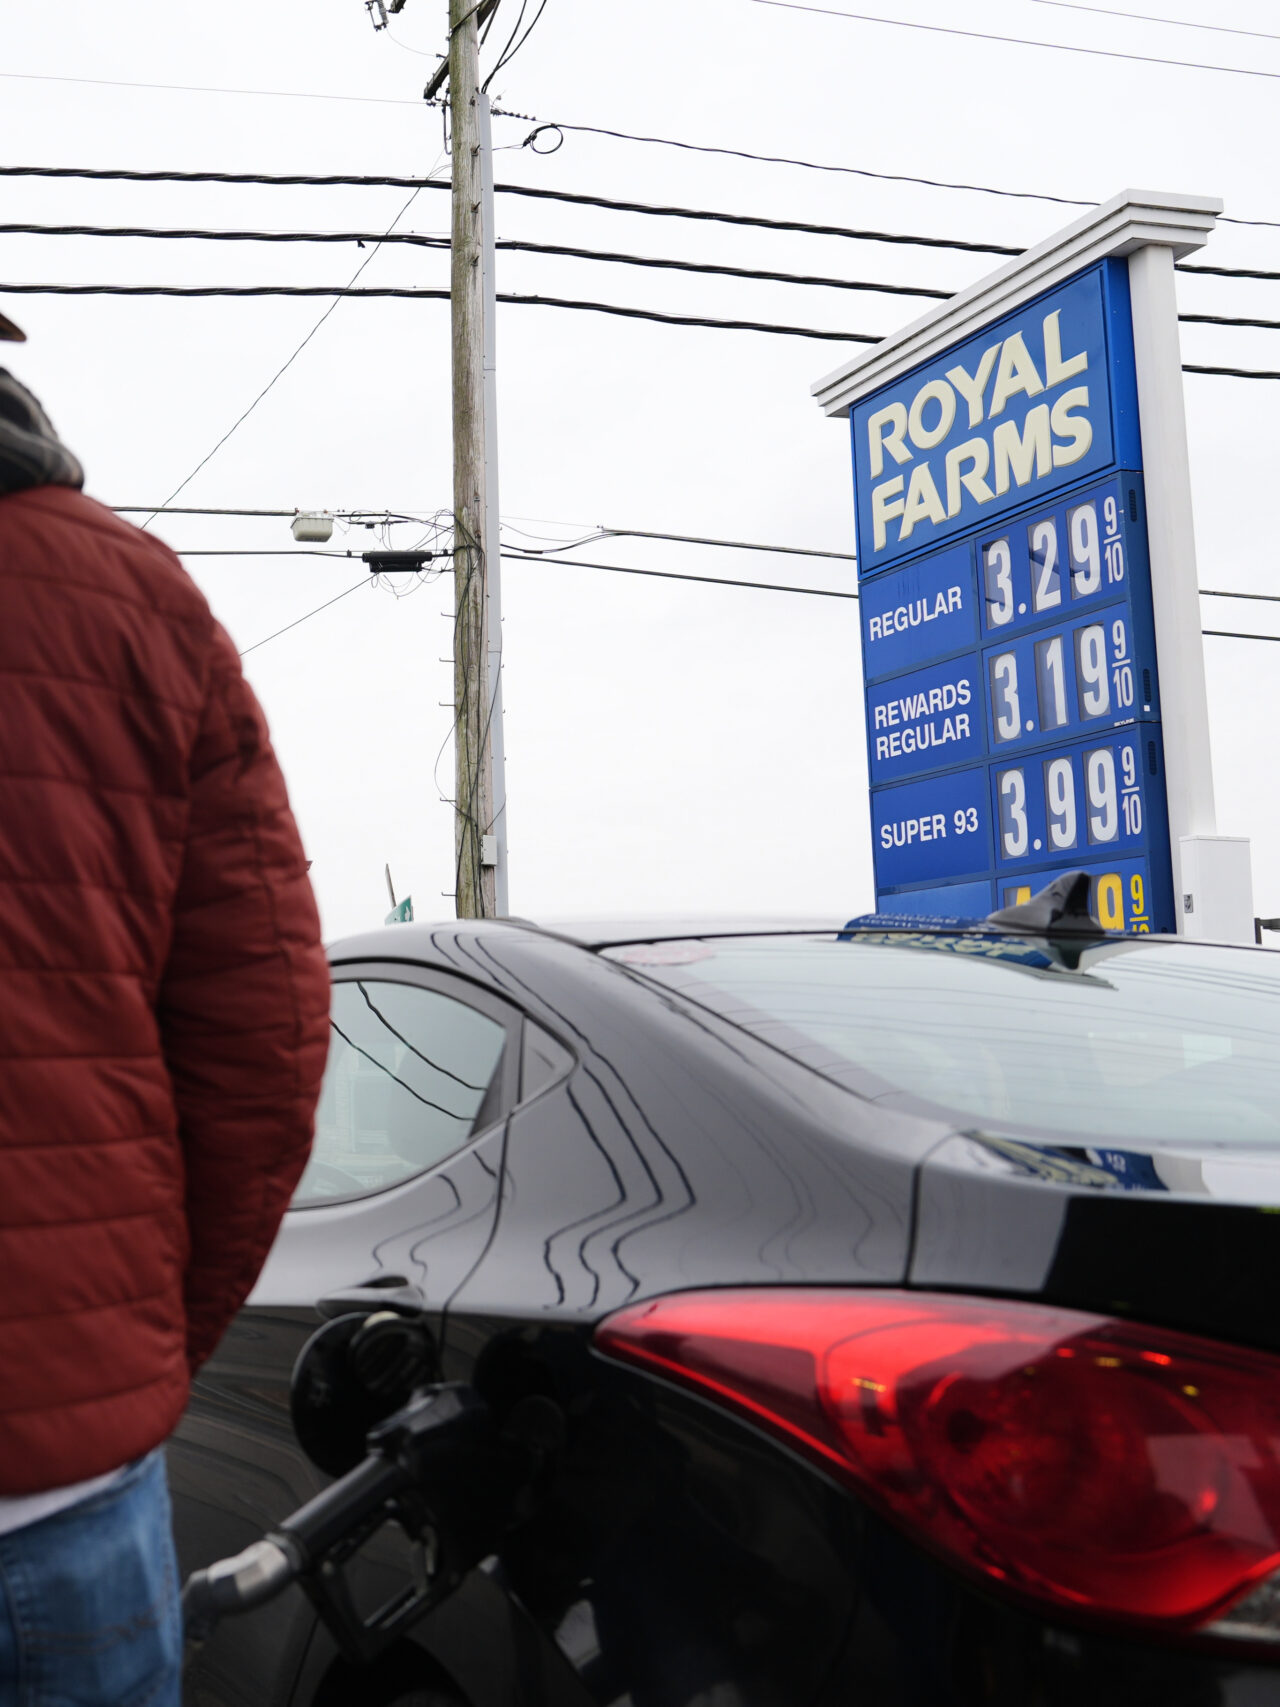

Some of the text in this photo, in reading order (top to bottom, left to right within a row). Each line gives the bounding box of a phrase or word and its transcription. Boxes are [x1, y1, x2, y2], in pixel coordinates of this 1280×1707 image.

[868, 308, 1089, 480] ROYAL
[871, 386, 1093, 552] FARMS
[869, 586, 963, 642] REGULAR
[986, 504, 1102, 626] 3.29
[874, 679, 972, 730] REWARDS
[875, 714, 971, 761] REGULAR
[993, 624, 1111, 741] 3.19
[880, 807, 979, 850] SUPER 93
[1001, 748, 1119, 858] 3.99
